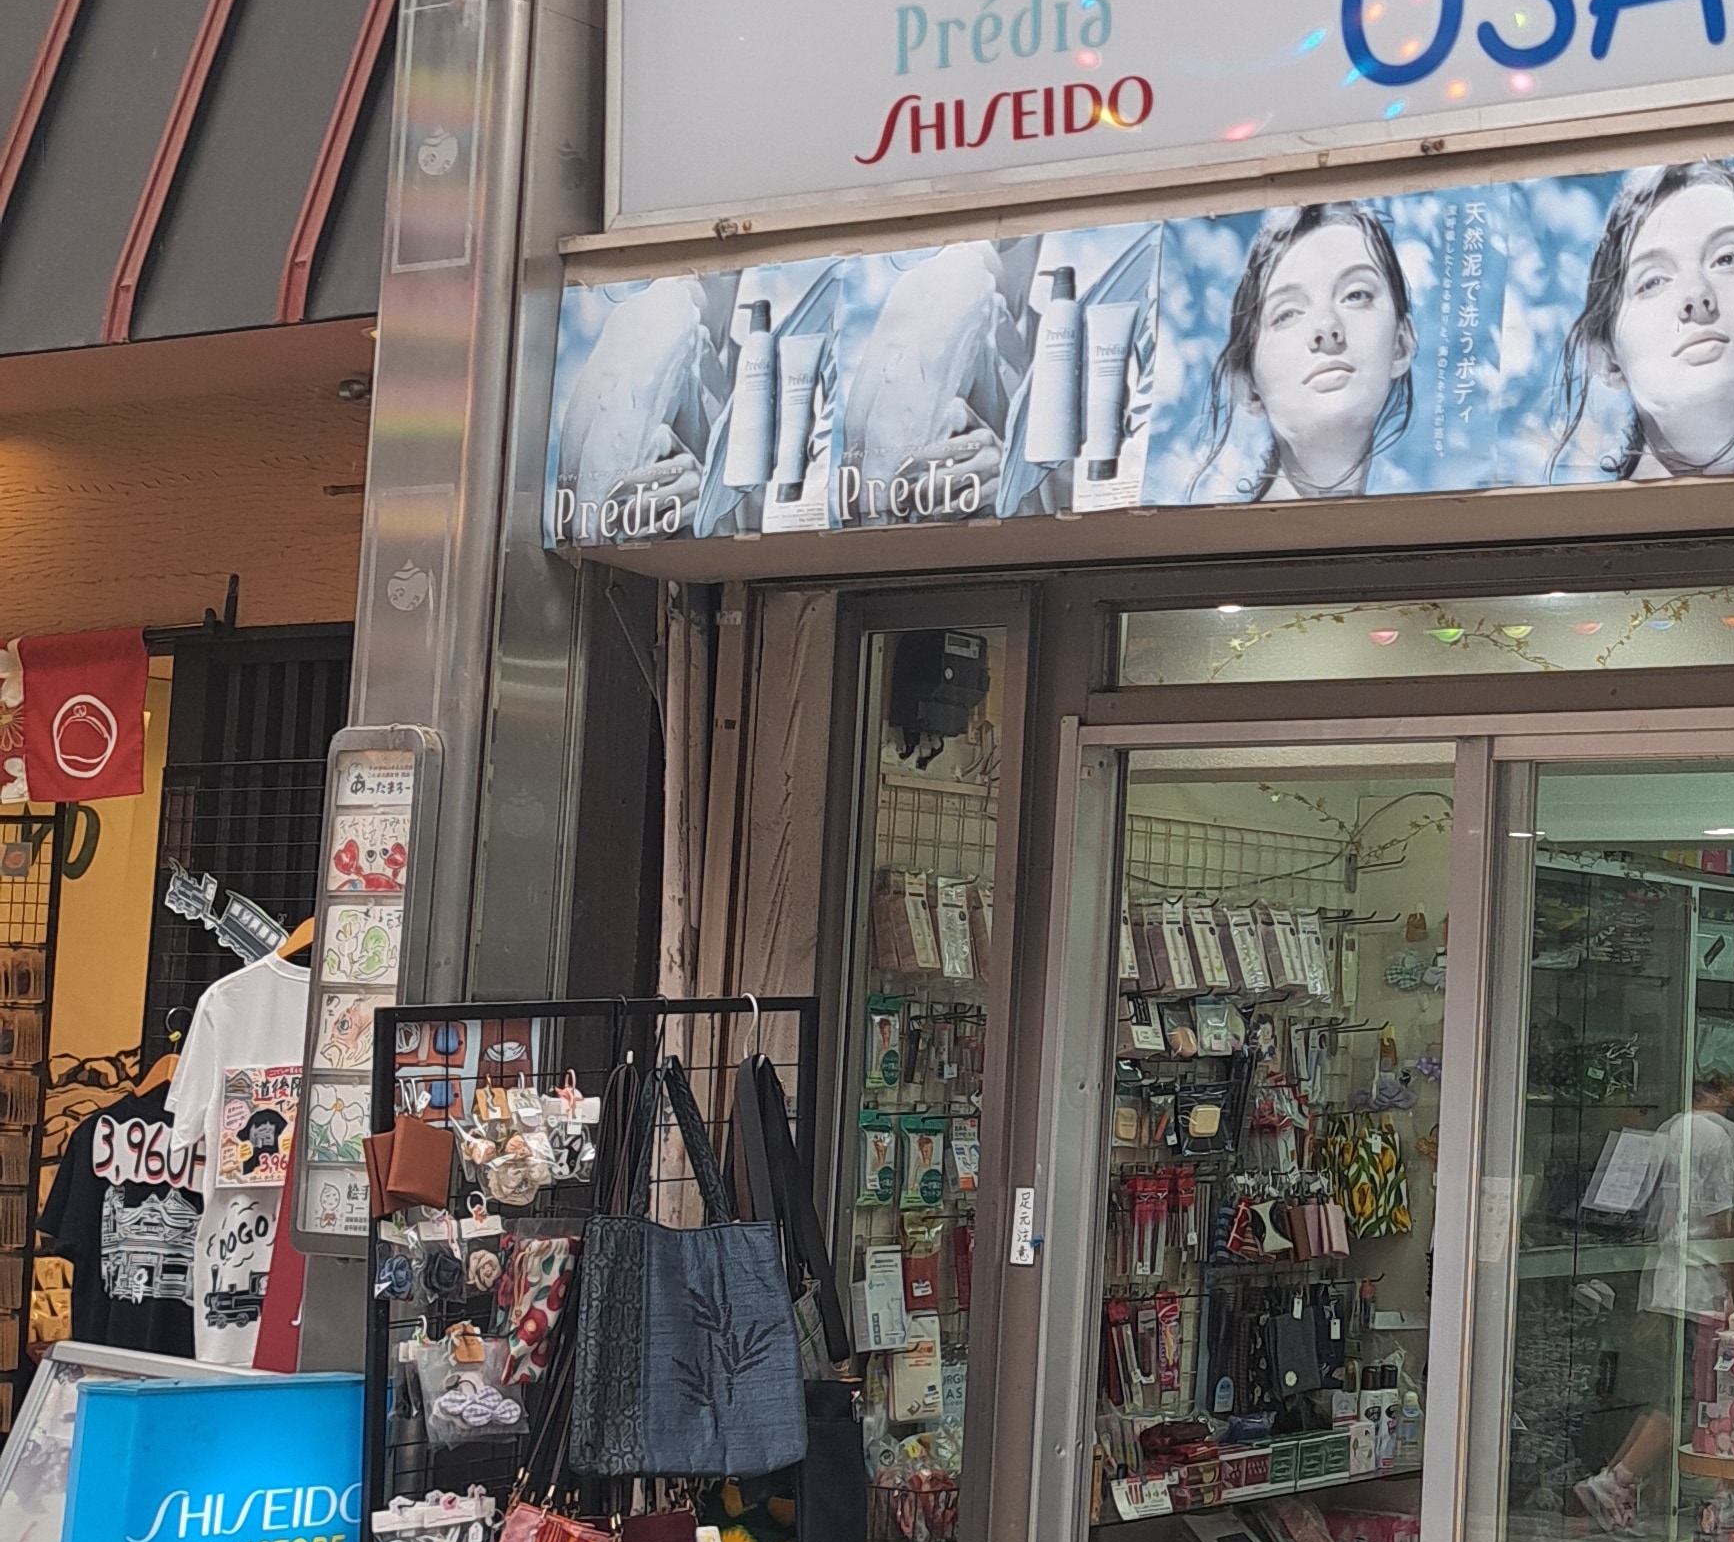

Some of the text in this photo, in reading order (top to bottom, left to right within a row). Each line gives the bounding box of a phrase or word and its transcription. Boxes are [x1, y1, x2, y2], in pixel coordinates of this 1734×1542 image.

[854, 75, 1154, 165] SHISEIDO
[1453, 201, 1487, 424] 天然泥で洗うボディ
[555, 480, 682, 540] Prédia
[839, 456, 981, 520] Prédia
